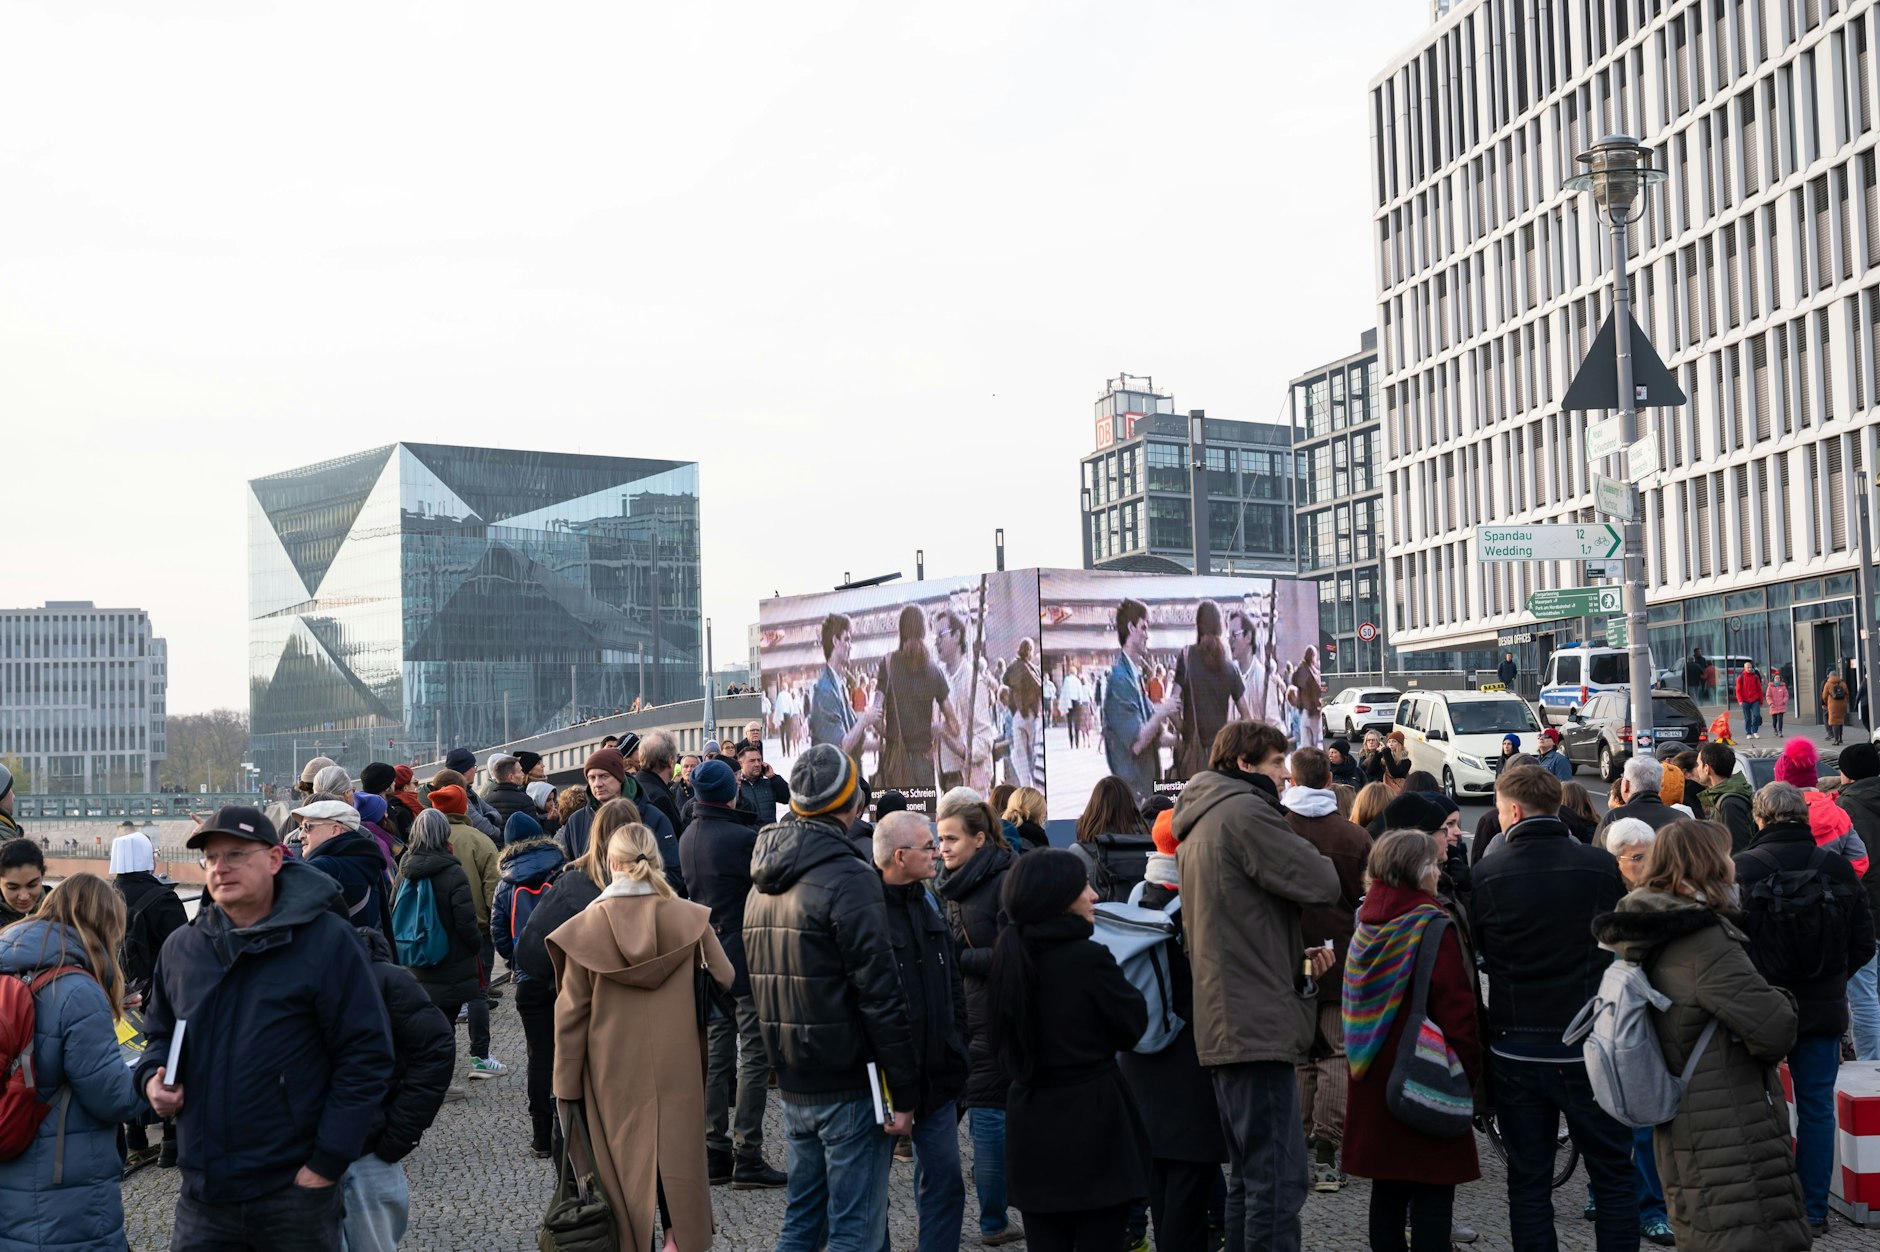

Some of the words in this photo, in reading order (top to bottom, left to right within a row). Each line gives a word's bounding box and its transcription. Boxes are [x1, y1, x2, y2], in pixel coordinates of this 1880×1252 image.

[1098, 423, 1112, 446] DB
[1484, 530, 1532, 543] Spandau
[1576, 529, 1585, 539] 12
[1485, 546, 1532, 557] Wedding
[1362, 628, 1372, 637] 50
[1498, 635, 1513, 647] DESIGN
[1514, 632, 1531, 645] OFFICES
[1799, 640, 1804, 654] 4
[910, 788, 936, 798] Schreien
[906, 801, 926, 811] sonen]
